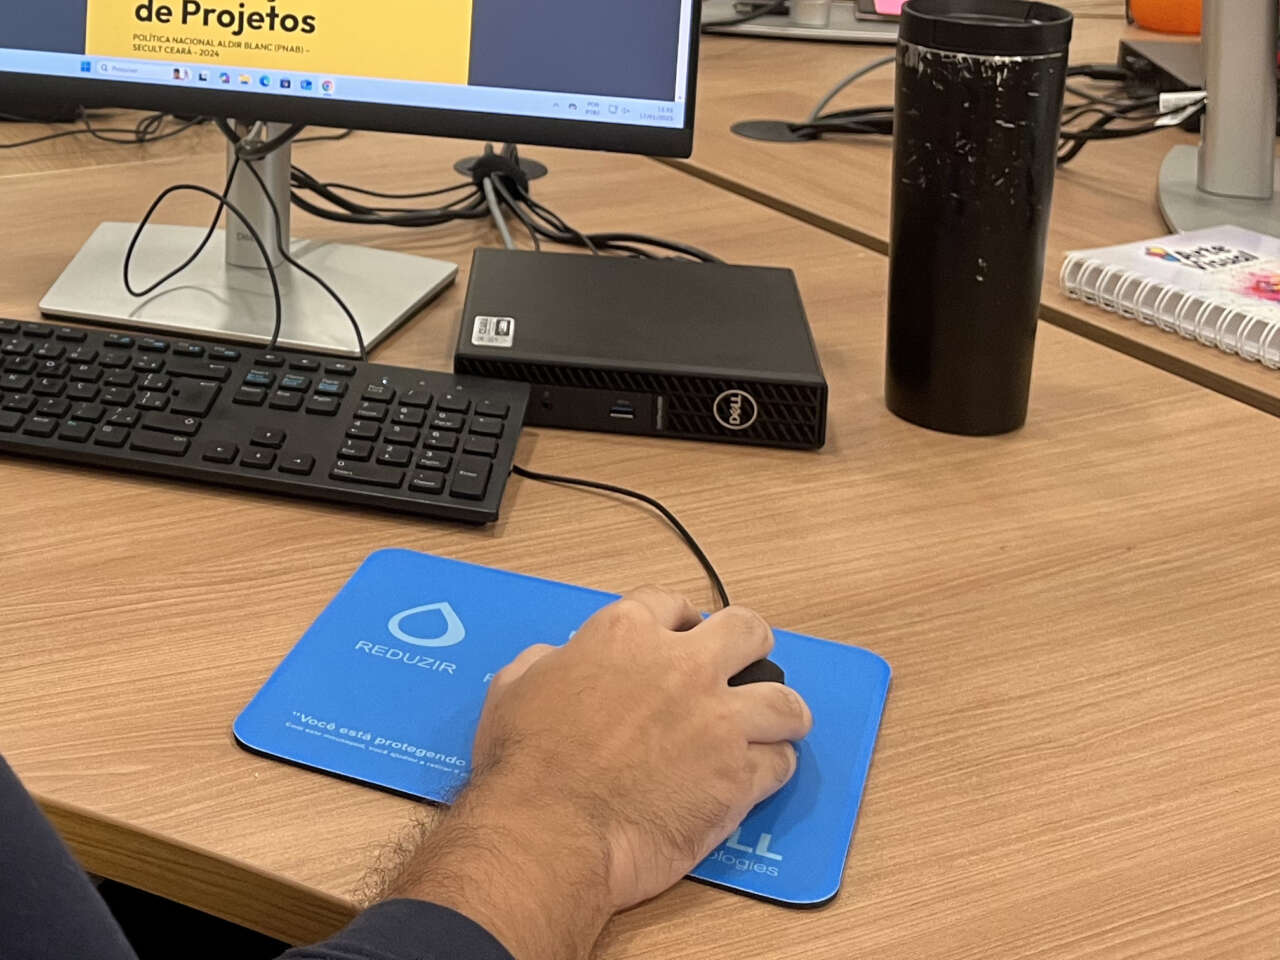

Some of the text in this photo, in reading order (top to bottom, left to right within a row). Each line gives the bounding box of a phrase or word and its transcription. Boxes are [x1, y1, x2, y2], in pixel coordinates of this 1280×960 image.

[181, 0, 317, 37] Projetos
[132, 33, 171, 44] POLÍTICA
[171, 36, 215, 48] NACIONAL
[217, 40, 242, 50] ALDIR
[244, 42, 273, 52] BLANC
[274, 44, 304, 55] (PNAB)
[132, 44, 163, 54] SECULT
[164, 46, 192, 56] CEARÁ
[199, 49, 220, 58] 2024
[728, 394, 742, 425] DELL
[354, 639, 457, 676] REDUZIR
[338, 726, 371, 742] está
[373, 736, 467, 768] protegendo
[726, 826, 783, 861] LL
